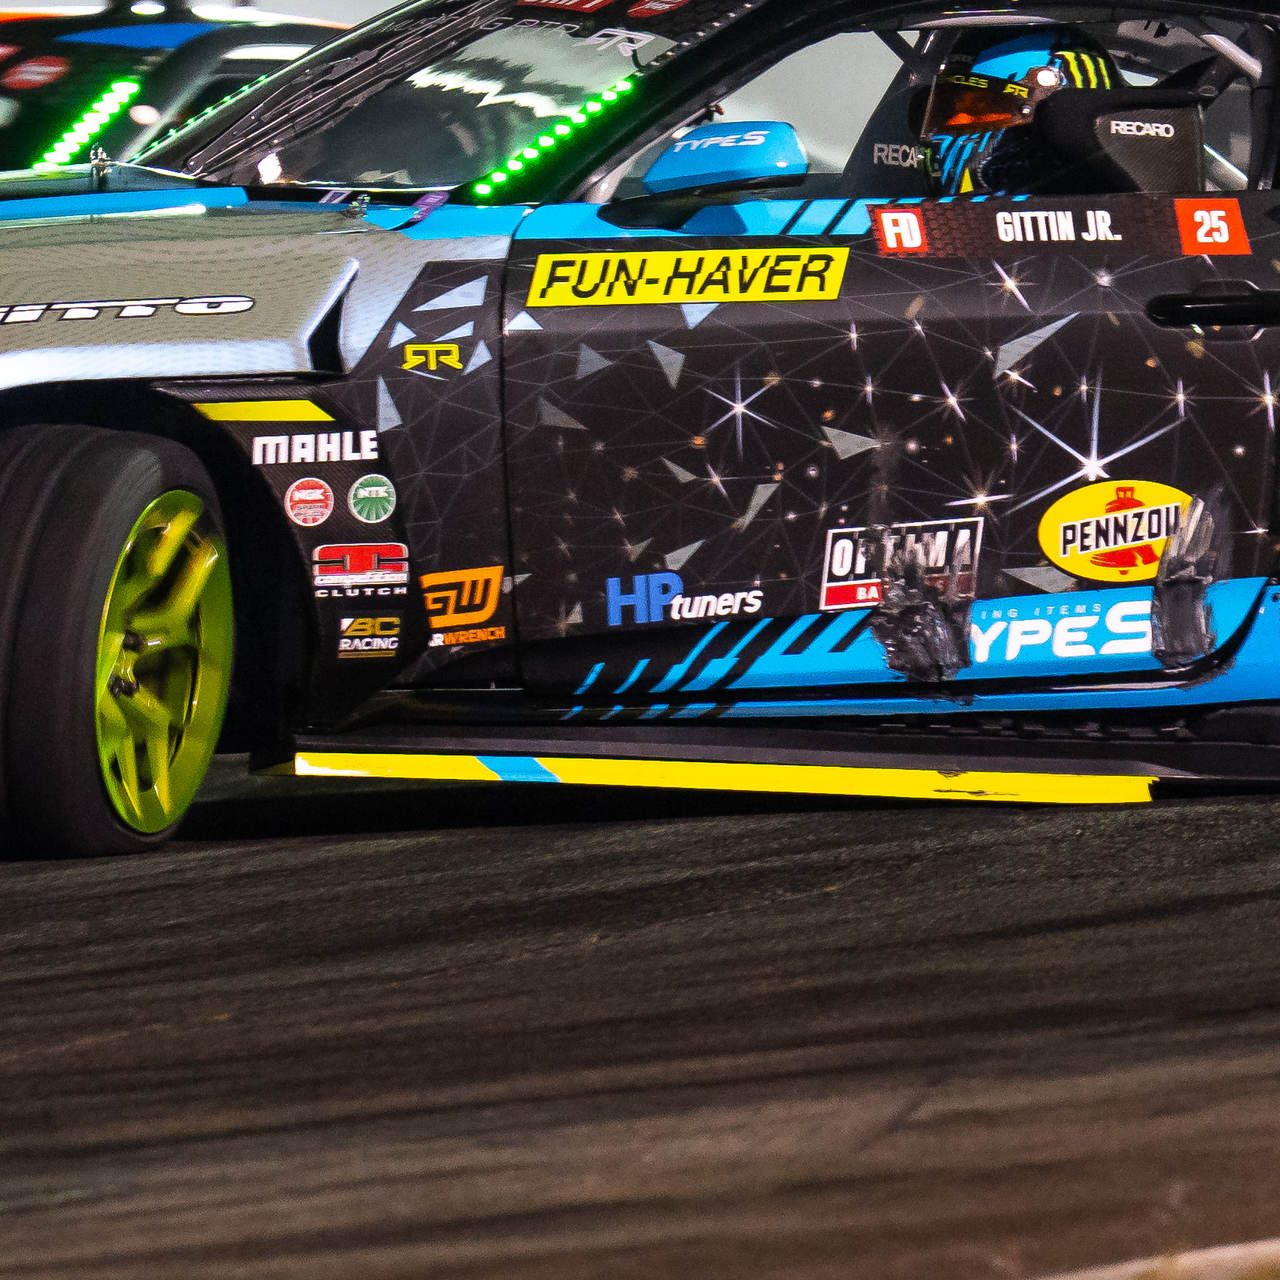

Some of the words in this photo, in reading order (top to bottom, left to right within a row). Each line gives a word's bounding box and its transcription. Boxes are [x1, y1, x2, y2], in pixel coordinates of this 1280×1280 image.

[1110, 120, 1175, 138] RECARO
[873, 142, 918, 168] RECA
[880, 209, 922, 249] FD
[996, 210, 1076, 242] GITTIN
[1081, 209, 1123, 242] JR.
[1193, 210, 1231, 243] 25
[539, 254, 835, 299] FUN-HAVER
[252, 429, 379, 465] MAHLE
[314, 587, 408, 598] CLUTCH
[1033, 603, 1102, 617] ITEMS
[338, 637, 399, 651] RACING
[427, 626, 506, 648] RWRENCH
